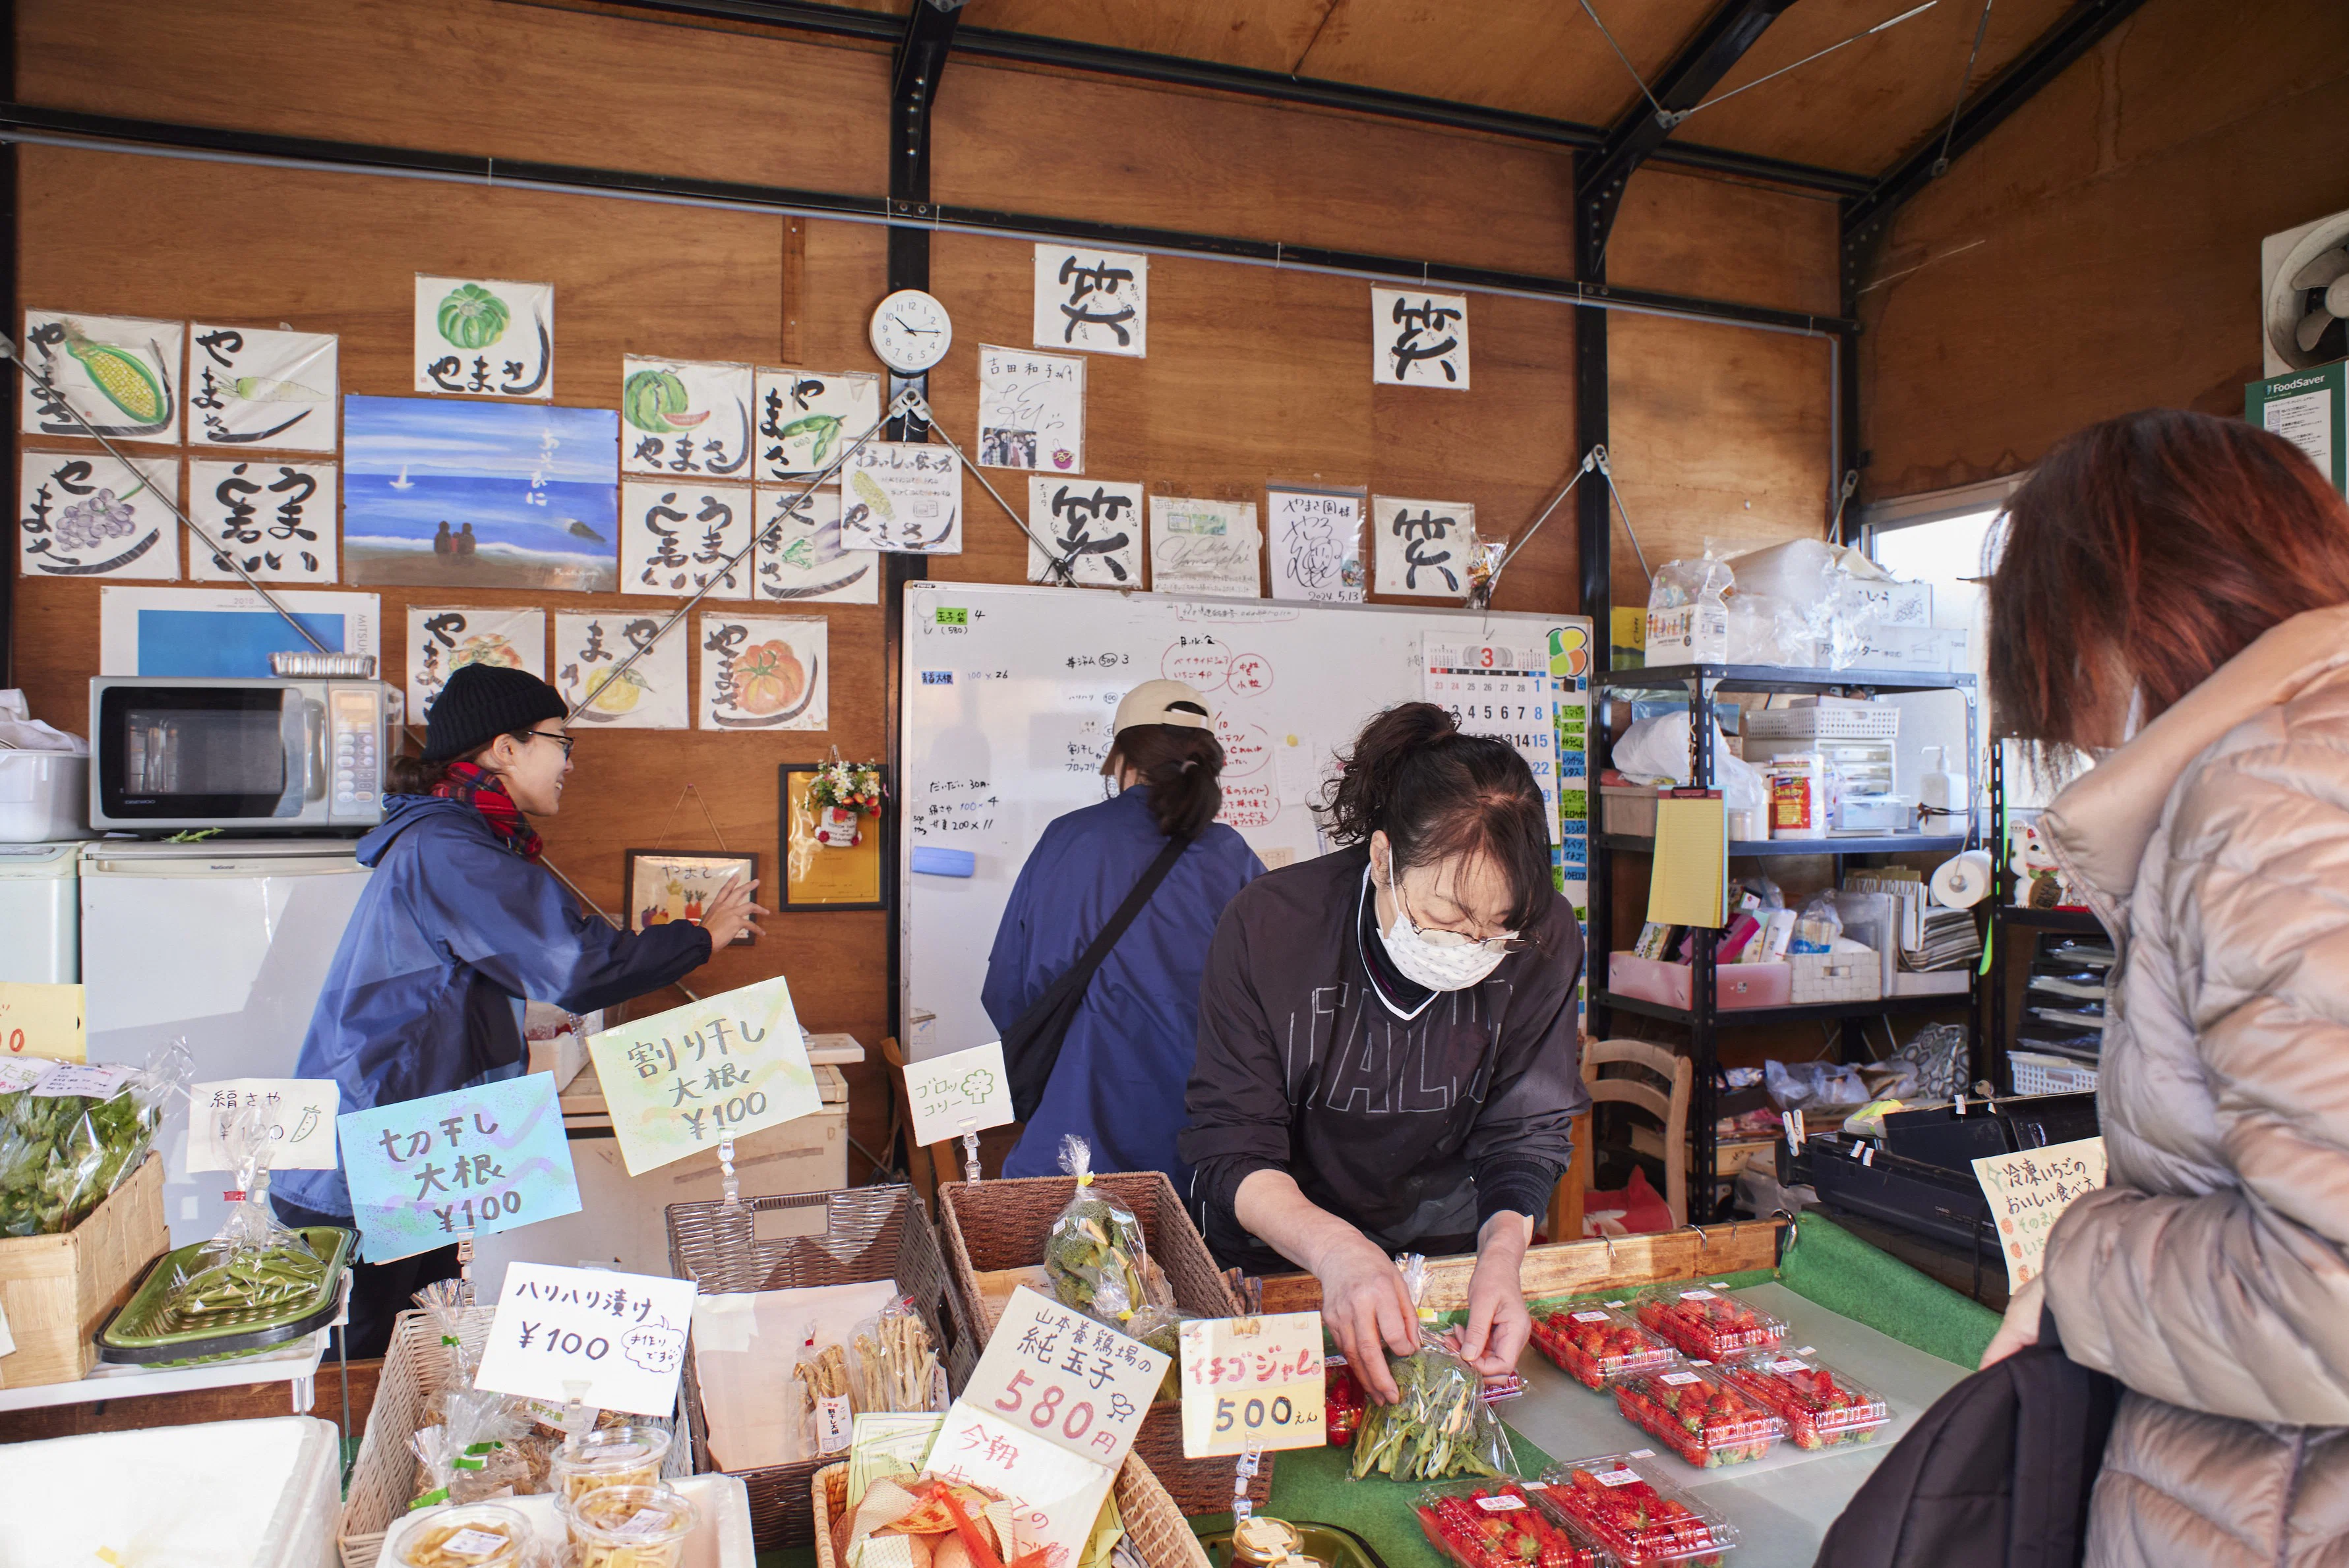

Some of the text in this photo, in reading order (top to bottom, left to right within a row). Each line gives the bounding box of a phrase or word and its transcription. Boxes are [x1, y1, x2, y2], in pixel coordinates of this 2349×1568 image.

[886, 312, 894, 321] 10
[930, 316, 936, 325] 2
[1059, 256, 1135, 346] 笑
[427, 306, 550, 394] やまさ
[885, 337, 891, 346] 8
[895, 348, 901, 357] 7
[920, 350, 926, 359] 5
[1391, 298, 1462, 382] 笑
[192, 330, 313, 442] やまさ
[2273, 375, 2325, 393] FoodSaver
[634, 399, 749, 474] やまさ
[759, 380, 839, 480] やまさ
[22, 460, 160, 574] やまさ
[213, 463, 262, 573] うまい
[265, 467, 318, 572] うまい
[843, 504, 955, 549] やまさ
[1052, 485, 1133, 581] 笑
[641, 492, 688, 589] うまい
[758, 494, 869, 598] やまさ
[1392, 508, 1458, 591] 笑
[937, 610, 985, 622] 玉子袋 4
[703, 625, 817, 726] やまさ
[1122, 654, 1129, 664] 3
[1481, 648, 1493, 668] 3
[1535, 680, 1540, 692] 1
[1468, 705, 1475, 718] 4
[1484, 706, 1491, 719] 5
[1501, 707, 1508, 719] 6
[1518, 707, 1525, 720] 7
[1535, 707, 1543, 720] 8
[1515, 734, 1548, 747] 14 15
[1533, 762, 1549, 775] 22
[960, 802, 976, 811] 100
[988, 796, 999, 807] 4
[952, 821, 969, 830] 200
[628, 1018, 765, 1080] 割り干し
[211, 1091, 280, 1108] 絹さや
[669, 1064, 751, 1109] 大根
[915, 1078, 957, 1098] ブロッ
[681, 1092, 767, 1140] ¥100
[924, 1100, 962, 1117] コリー
[379, 1113, 498, 1163] 切干し
[415, 1154, 506, 1201] 大根
[2002, 1157, 2086, 1188] 冷凍いちごの
[433, 1190, 521, 1233] ¥100
[516, 1281, 653, 1323] ハリハリ漬け
[518, 1320, 610, 1360] ¥100
[631, 1335, 667, 1346] 手作り
[1017, 1327, 1114, 1389] 純玉子
[1036, 1308, 1151, 1372] 山本養鶏場の
[1189, 1345, 1321, 1385] イチゴジャム
[828, 1408, 839, 1436] 割干し大根
[960, 1422, 1020, 1470] 今朝
